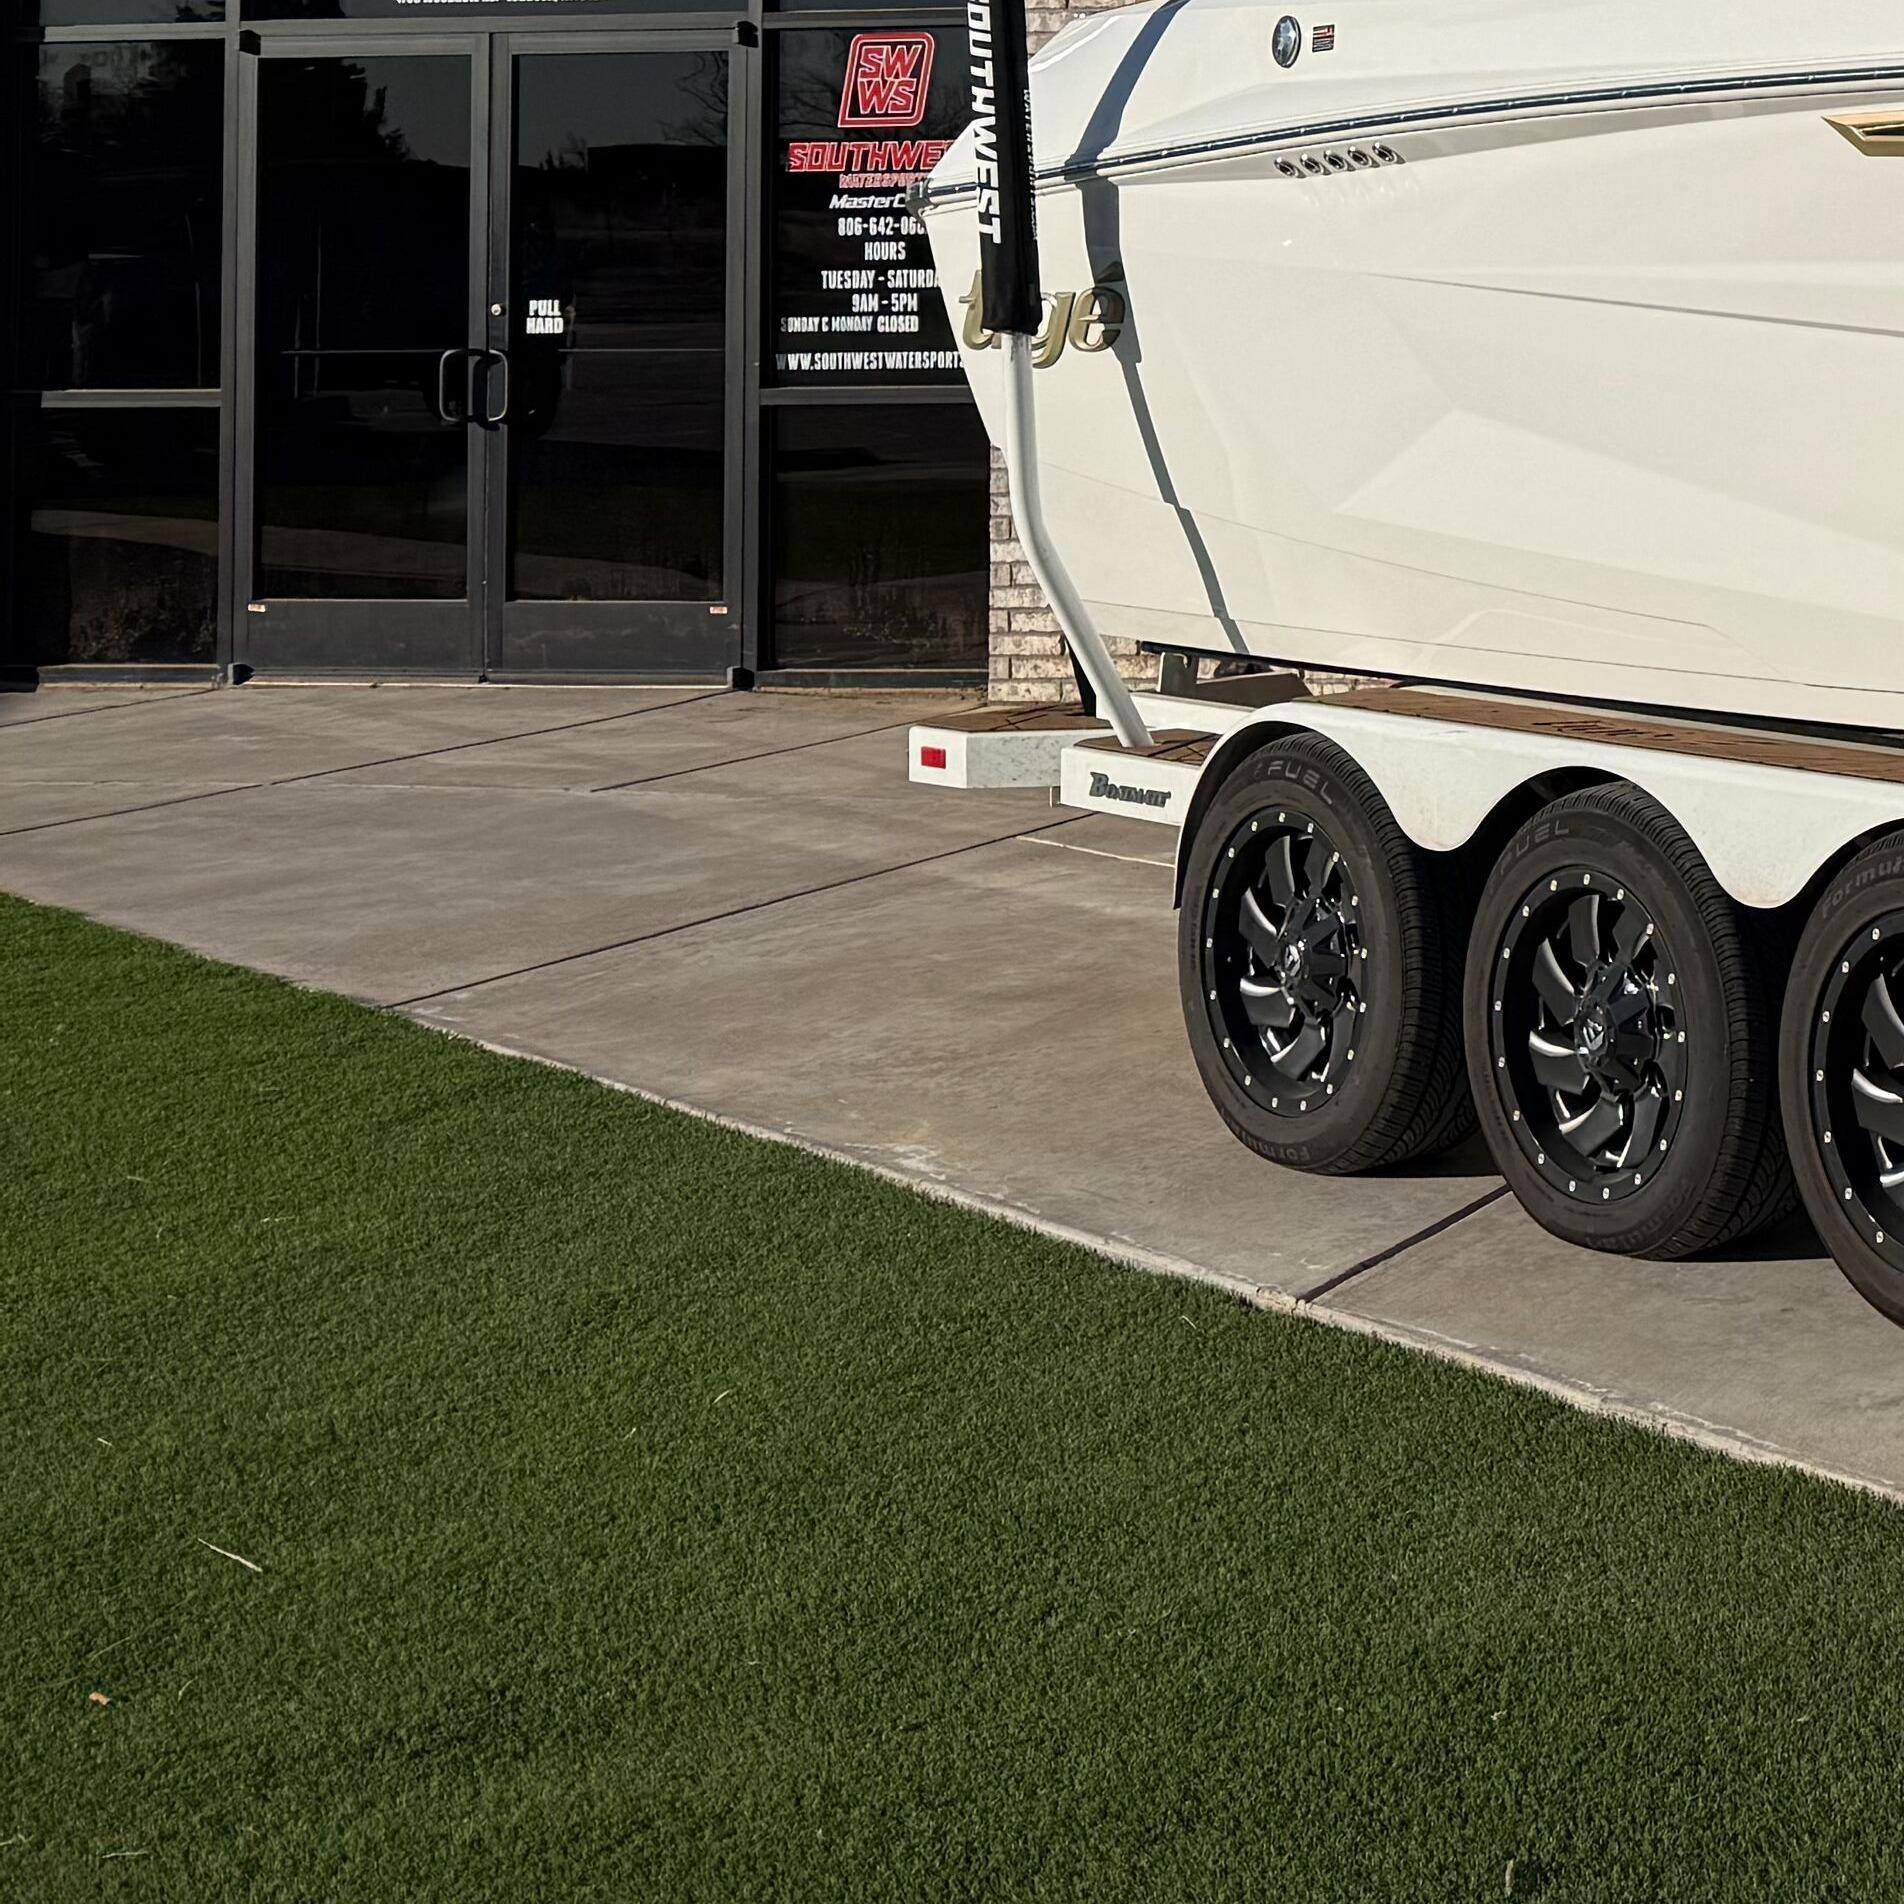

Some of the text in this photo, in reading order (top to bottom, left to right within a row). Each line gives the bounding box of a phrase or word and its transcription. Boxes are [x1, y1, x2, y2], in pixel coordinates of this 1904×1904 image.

[858, 45, 923, 80] SW
[857, 77, 917, 115] WS
[788, 139, 954, 173] SOUTHWE
[837, 215, 928, 237] 806-642-06
[864, 241, 906, 261] HOURS
[820, 269, 877, 290] TUESDAY
[528, 299, 562, 316] PULL
[851, 292, 879, 313] 9AM
[891, 292, 918, 313] 5PM
[526, 317, 564, 334] HARD
[831, 315, 874, 333] MONDAY
[876, 314, 919, 333] CLOSED
[1267, 759, 1333, 806] FUEL
